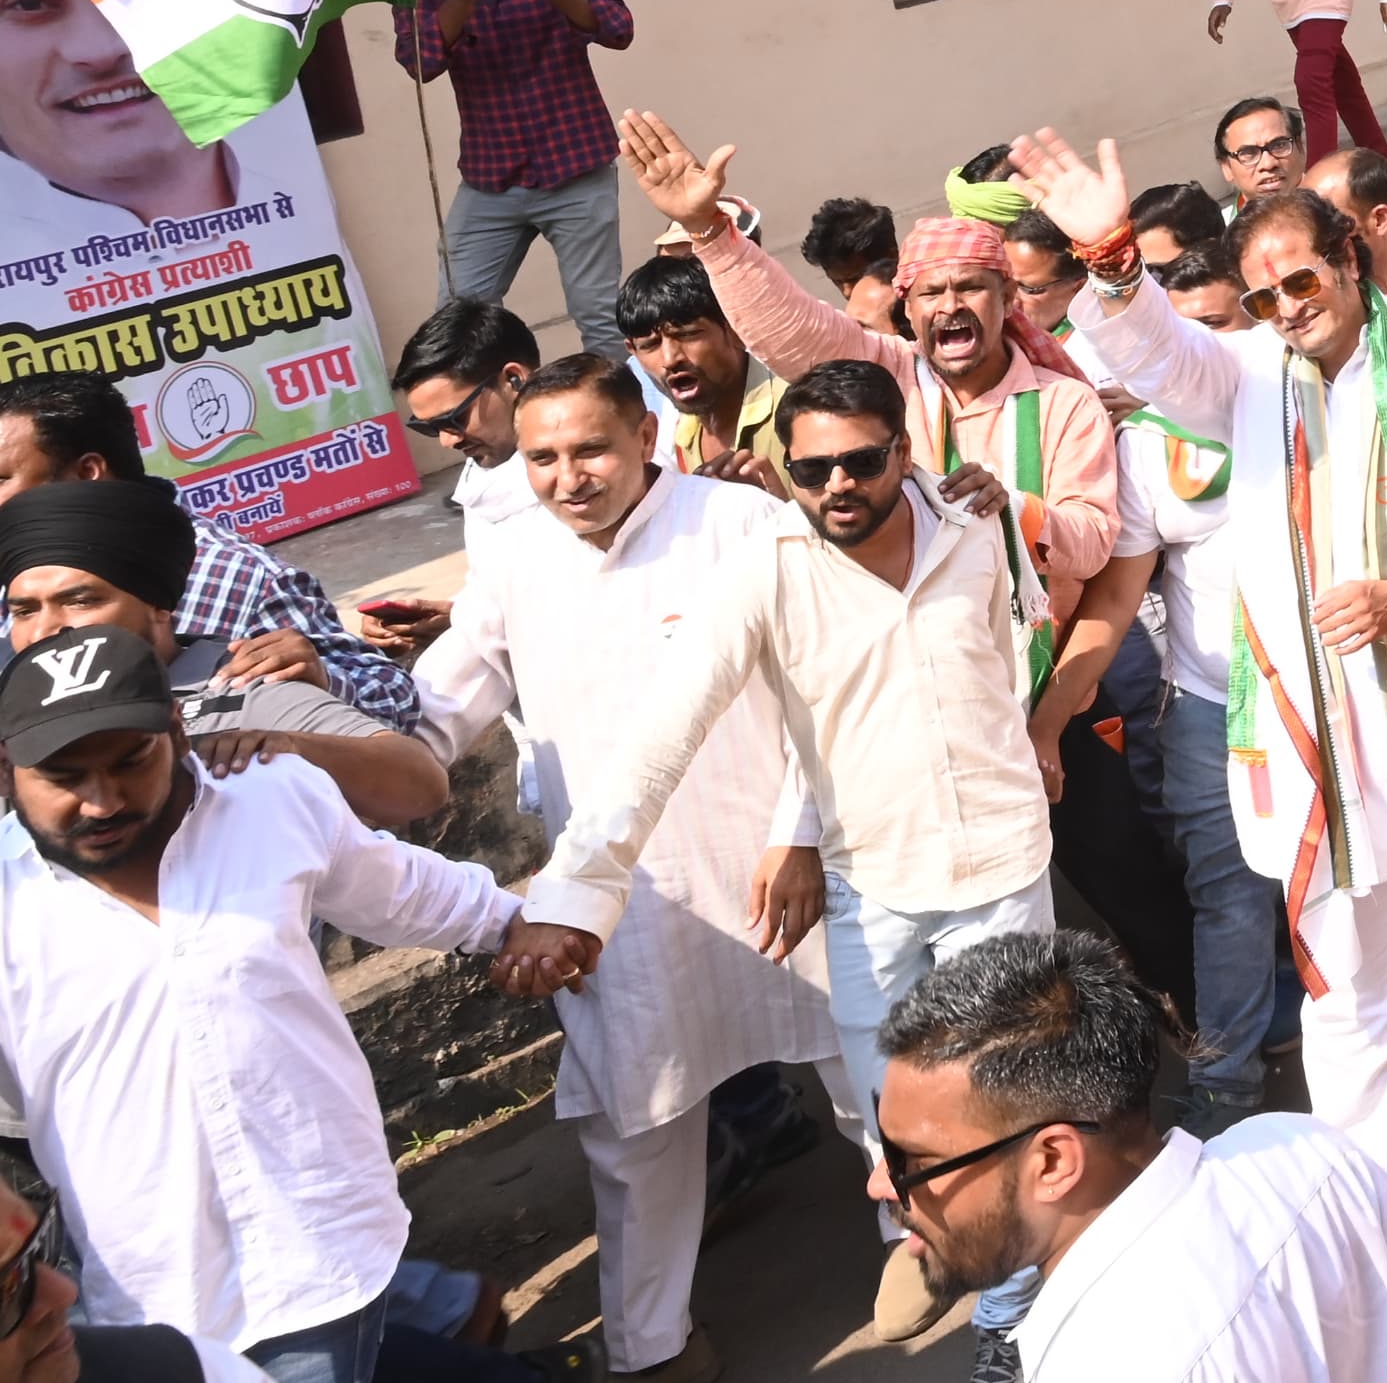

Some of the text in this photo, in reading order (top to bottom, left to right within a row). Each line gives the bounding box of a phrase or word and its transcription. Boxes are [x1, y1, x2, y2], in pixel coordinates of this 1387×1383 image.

[71, 230, 150, 268] पश्चिम
[152, 201, 271, 250] विधानसभा
[273, 191, 296, 218] से
[64, 240, 254, 313] कांग्रेस प्रत्याशी
[162, 265, 346, 354] उपाध्याय
[266, 345, 358, 406] छाप
[234, 454, 308, 498] प्रचण्ड
[310, 428, 360, 471] मतों
[362, 424, 387, 455] से
[235, 494, 284, 526] बनायें
